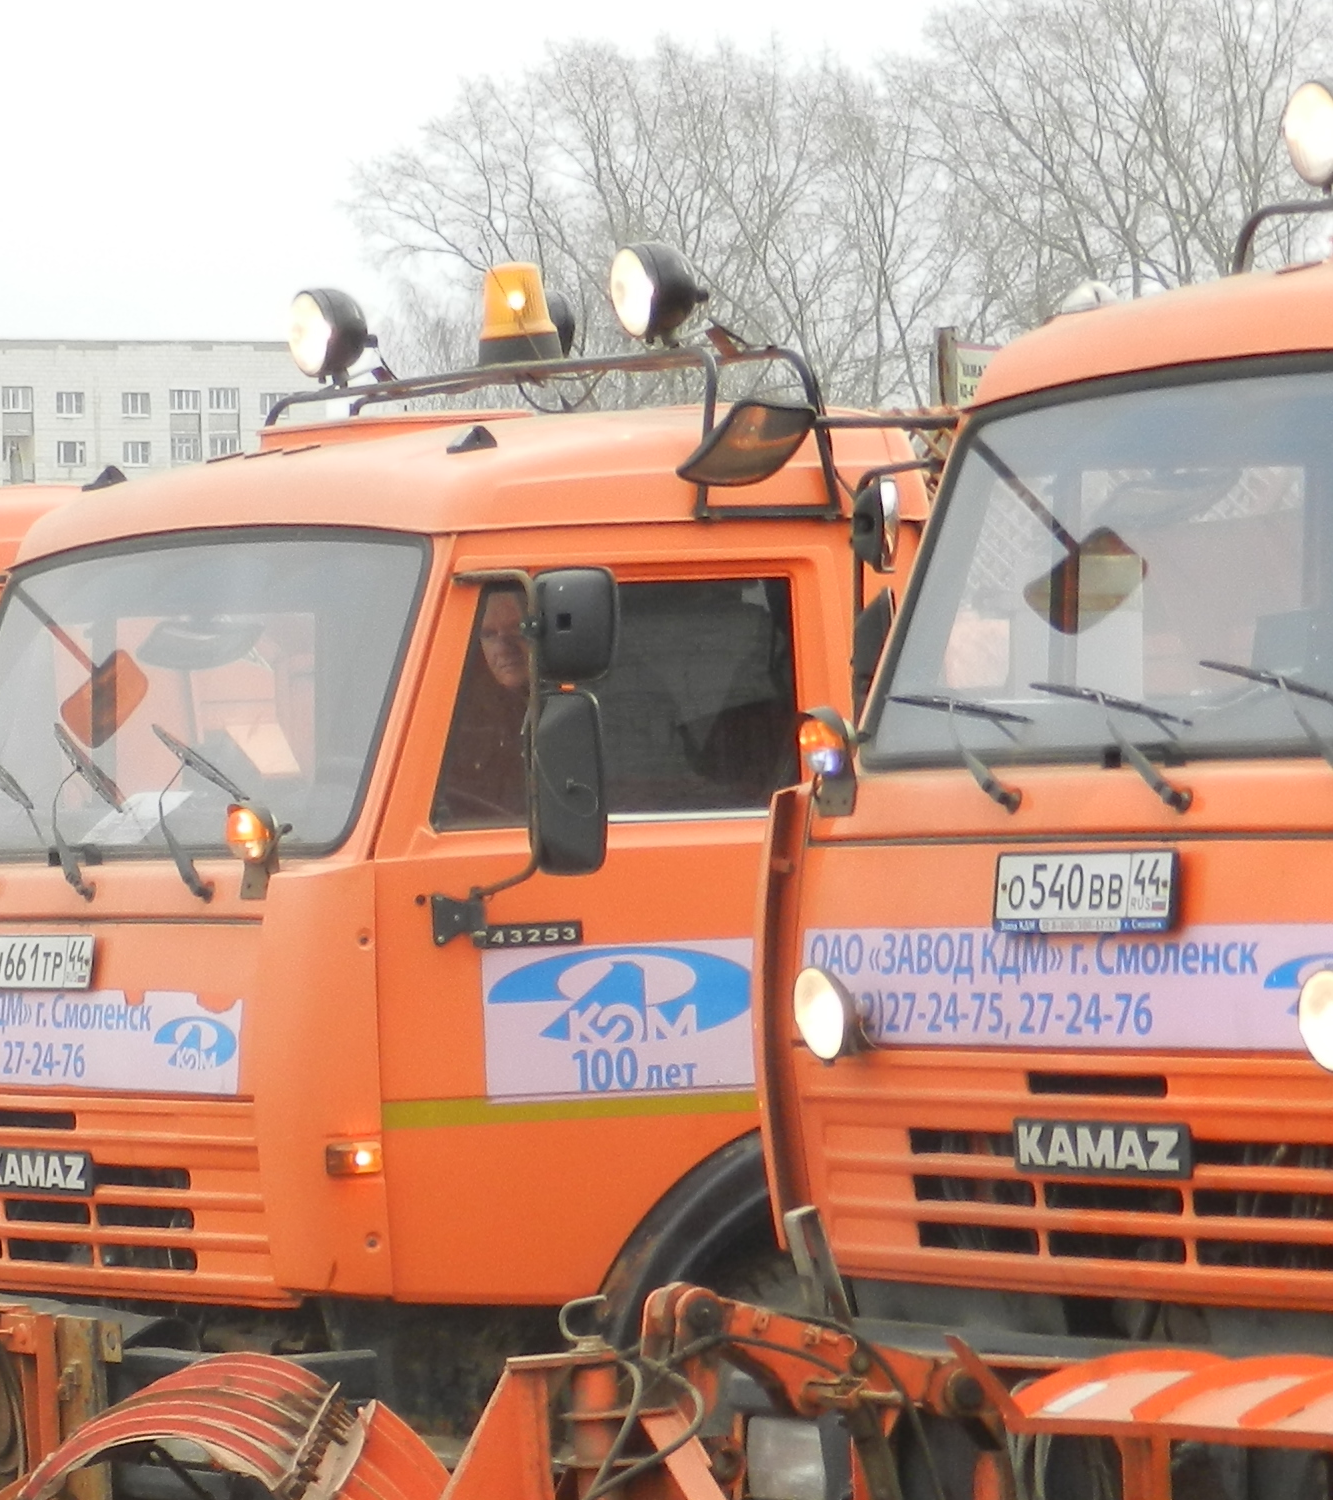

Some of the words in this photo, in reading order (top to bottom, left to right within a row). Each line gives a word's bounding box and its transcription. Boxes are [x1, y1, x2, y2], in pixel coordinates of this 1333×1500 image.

[1133, 859, 1160, 896] 44
[491, 926, 577, 944] 43253
[810, 933, 864, 975] ОАО
[869, 933, 975, 985] «ЗАВОД
[981, 932, 1064, 985] КДМ»
[1070, 943, 1089, 975] г.
[1096, 934, 1258, 976] Смоленск
[35, 1002, 47, 1028] г.
[51, 993, 153, 1031] Смоленск
[1019, 991, 1154, 1036] 27-24-76
[3, 1040, 86, 1079] 27-24-76
[572, 1046, 639, 1093] 100
[645, 1062, 698, 1089] лет
[1017, 1122, 1181, 1172] KAMAZ
